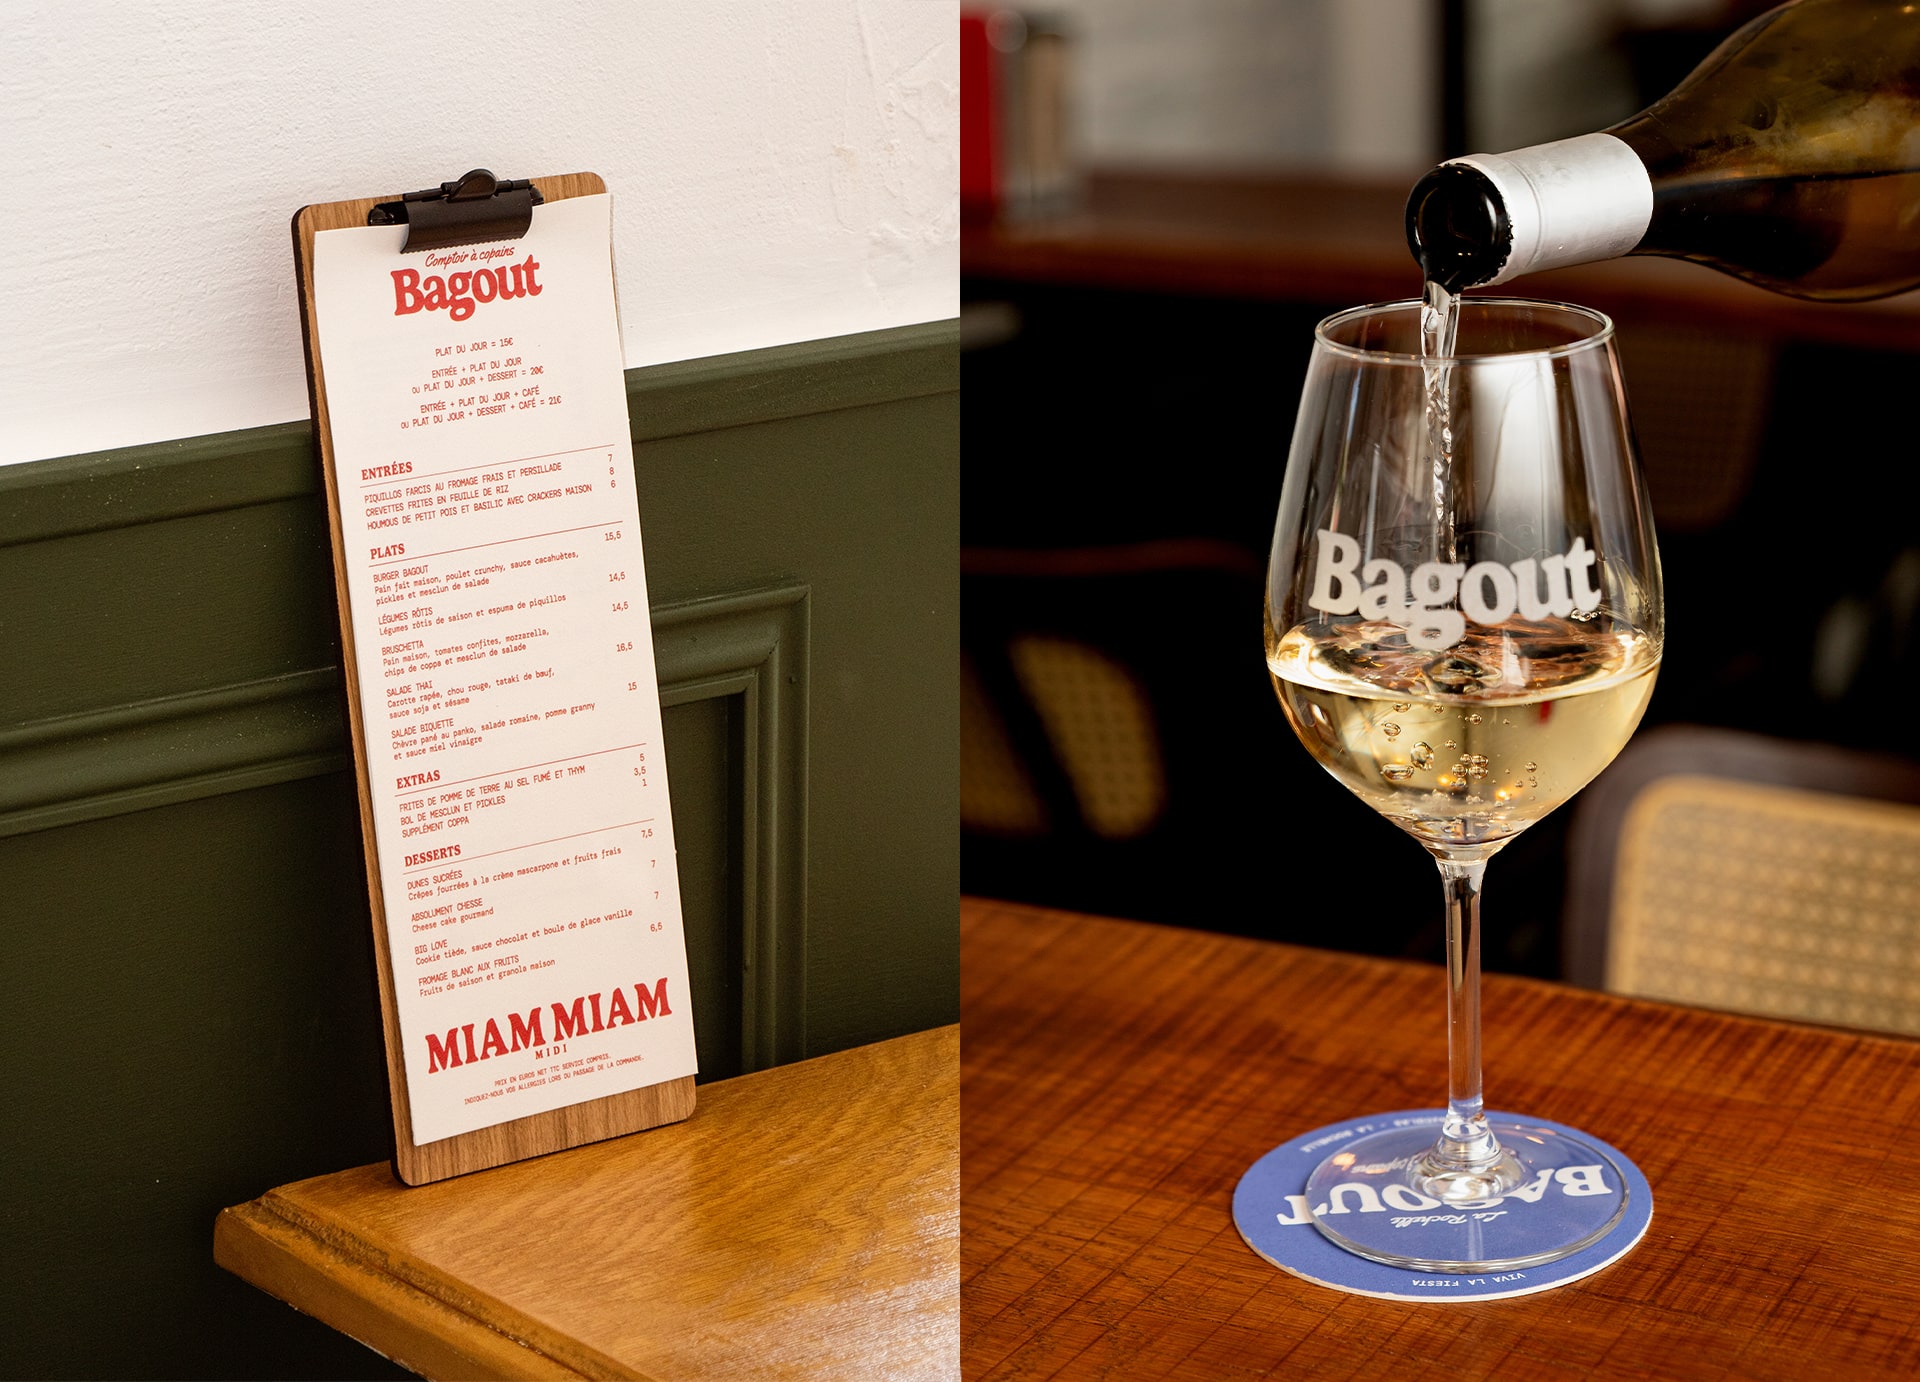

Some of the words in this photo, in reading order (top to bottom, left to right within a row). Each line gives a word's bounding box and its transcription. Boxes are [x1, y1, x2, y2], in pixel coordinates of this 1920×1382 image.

[424, 250, 469, 271] Comptoir
[470, 248, 477, 263] à
[479, 244, 515, 265] copains
[390, 253, 543, 322] Bagout
[435, 346, 452, 357] PLAT
[456, 344, 466, 354] DU
[470, 341, 488, 352] JOUR
[499, 337, 514, 348] 15€
[431, 365, 458, 379] ENTRÉE
[469, 362, 487, 373] PLAT
[490, 360, 500, 370] DU
[504, 356, 522, 368] JOUR
[423, 381, 441, 392] PLAT
[444, 380, 454, 389] DU
[458, 376, 476, 387] JOUR
[487, 369, 518, 382] DESSERT
[530, 365, 544, 376] 20€
[420, 400, 447, 414] ENTRÉE
[458, 396, 475, 408] PLAT
[478, 394, 489, 404] DU
[492, 391, 511, 402] JOUR
[522, 384, 540, 398] CAFÉ
[412, 416, 430, 427] PLAT
[433, 414, 444, 424] DU
[446, 410, 465, 422] JOUR
[476, 404, 506, 417] DESSERT
[518, 397, 537, 410] CAFÉ
[548, 395, 562, 406] 21€
[361, 460, 413, 481] ENTRÉES
[364, 489, 403, 504] PIQUILLOS
[405, 484, 432, 497] FARCIS
[435, 482, 445, 492] AU
[447, 476, 479, 489] FROMAGE
[482, 472, 504, 484] FRAIS
[507, 469, 516, 480] ET
[520, 462, 562, 477] PERSILLADE
[365, 502, 405, 518] CREVETTES
[407, 497, 434, 510] FRITES
[436, 495, 447, 505] EN
[449, 489, 480, 502] FEUILLE
[482, 487, 493, 497] DE
[495, 484, 509, 495] RIZ
[367, 516, 399, 530] HOUMOUS
[402, 514, 412, 524] DE
[414, 510, 436, 522] PETIT
[440, 506, 458, 518] POIS
[460, 504, 470, 514] ET
[473, 498, 504, 512] BASILIC
[507, 495, 525, 506] AVEC
[527, 488, 563, 503] CRACKERS
[565, 484, 592, 496] MAISON
[605, 530, 622, 542] 15,5
[370, 543, 406, 560] PLATS
[373, 570, 400, 583] BURGER
[402, 564, 429, 578] BAGOUT
[374, 584, 392, 594] Pain
[394, 581, 410, 593] fait
[413, 576, 442, 587] maison,
[445, 570, 471, 583] poulet
[474, 564, 506, 576] crunchy,
[510, 559, 532, 569] sauce
[534, 552, 579, 565] cacahuètes,
[609, 571, 626, 582] 14,5
[376, 594, 405, 607] pickles
[408, 591, 416, 599] et
[419, 585, 449, 597] mesclun
[452, 582, 461, 591] de
[464, 576, 490, 589] salade
[1308, 528, 1602, 650] Bagout
[378, 611, 409, 626] LÉGUMES
[411, 606, 434, 619] RÔTIS
[379, 624, 409, 637] Légumes
[412, 618, 433, 630] rôtis
[435, 616, 445, 625] de
[448, 612, 473, 623] saison
[476, 609, 485, 617] et
[488, 604, 514, 616] espuma
[516, 601, 526, 610] de
[529, 594, 566, 609] piquillos
[612, 601, 629, 612] 14,5
[381, 640, 424, 656] BRUSCHETTA
[616, 641, 633, 652] 16,5
[386, 684, 412, 698] SALADE
[415, 680, 433, 691] THAI
[628, 681, 638, 691] 15
[391, 725, 417, 739] SALADE
[420, 717, 454, 733] BIQUETTE
[396, 769, 441, 790] EXTRAS
[634, 766, 647, 777] 3,5
[399, 799, 425, 813] FRITES
[427, 796, 437, 807] DE
[440, 790, 463, 804] POMME
[466, 787, 476, 798] DE
[479, 782, 501, 795] TERRE
[504, 780, 514, 790] AU
[516, 777, 530, 787] SEL
[533, 770, 552, 784] FUMÉ
[554, 769, 563, 779] ET
[567, 765, 586, 776] THYM
[400, 815, 414, 826] BOL
[417, 812, 427, 822] DE
[429, 804, 461, 819] MESCLUN
[463, 802, 473, 812] ET
[476, 795, 506, 809] PICKLES
[402, 821, 444, 838] SUPPLÉMENT
[447, 816, 470, 828] COPPA
[641, 828, 653, 839] 7,5
[404, 844, 462, 868] DESSERTS
[407, 877, 430, 890] DUNES
[432, 869, 463, 885] SUCRÉES
[411, 904, 453, 922] ABSOLUMENT
[456, 897, 483, 912] CHESSE
[412, 922, 437, 933] Cheese
[440, 916, 457, 926] cake
[460, 906, 494, 924] gourmand
[650, 922, 663, 932] 6,5
[414, 944, 428, 955] BIG
[430, 939, 448, 951] LOVE
[418, 971, 448, 987] FROMAGE
[451, 965, 474, 979] BLANC
[477, 961, 491, 972] AUX
[493, 954, 520, 968] FRUITS
[419, 986, 443, 997] Fruits
[446, 982, 455, 991] de
[458, 976, 484, 988] saison
[486, 973, 495, 981] et
[498, 965, 527, 980] granola
[530, 959, 556, 970] maison
[425, 1006, 547, 1075] MIAM
[550, 977, 673, 1043] MIAM
[535, 1043, 567, 1060] MIDI
[1390, 1214, 1468, 1229] Rochelle
[1472, 1211, 1508, 1223] La
[1412, 1279, 1459, 1287] FIESTA
[1492, 1272, 1526, 1284] VIVA
